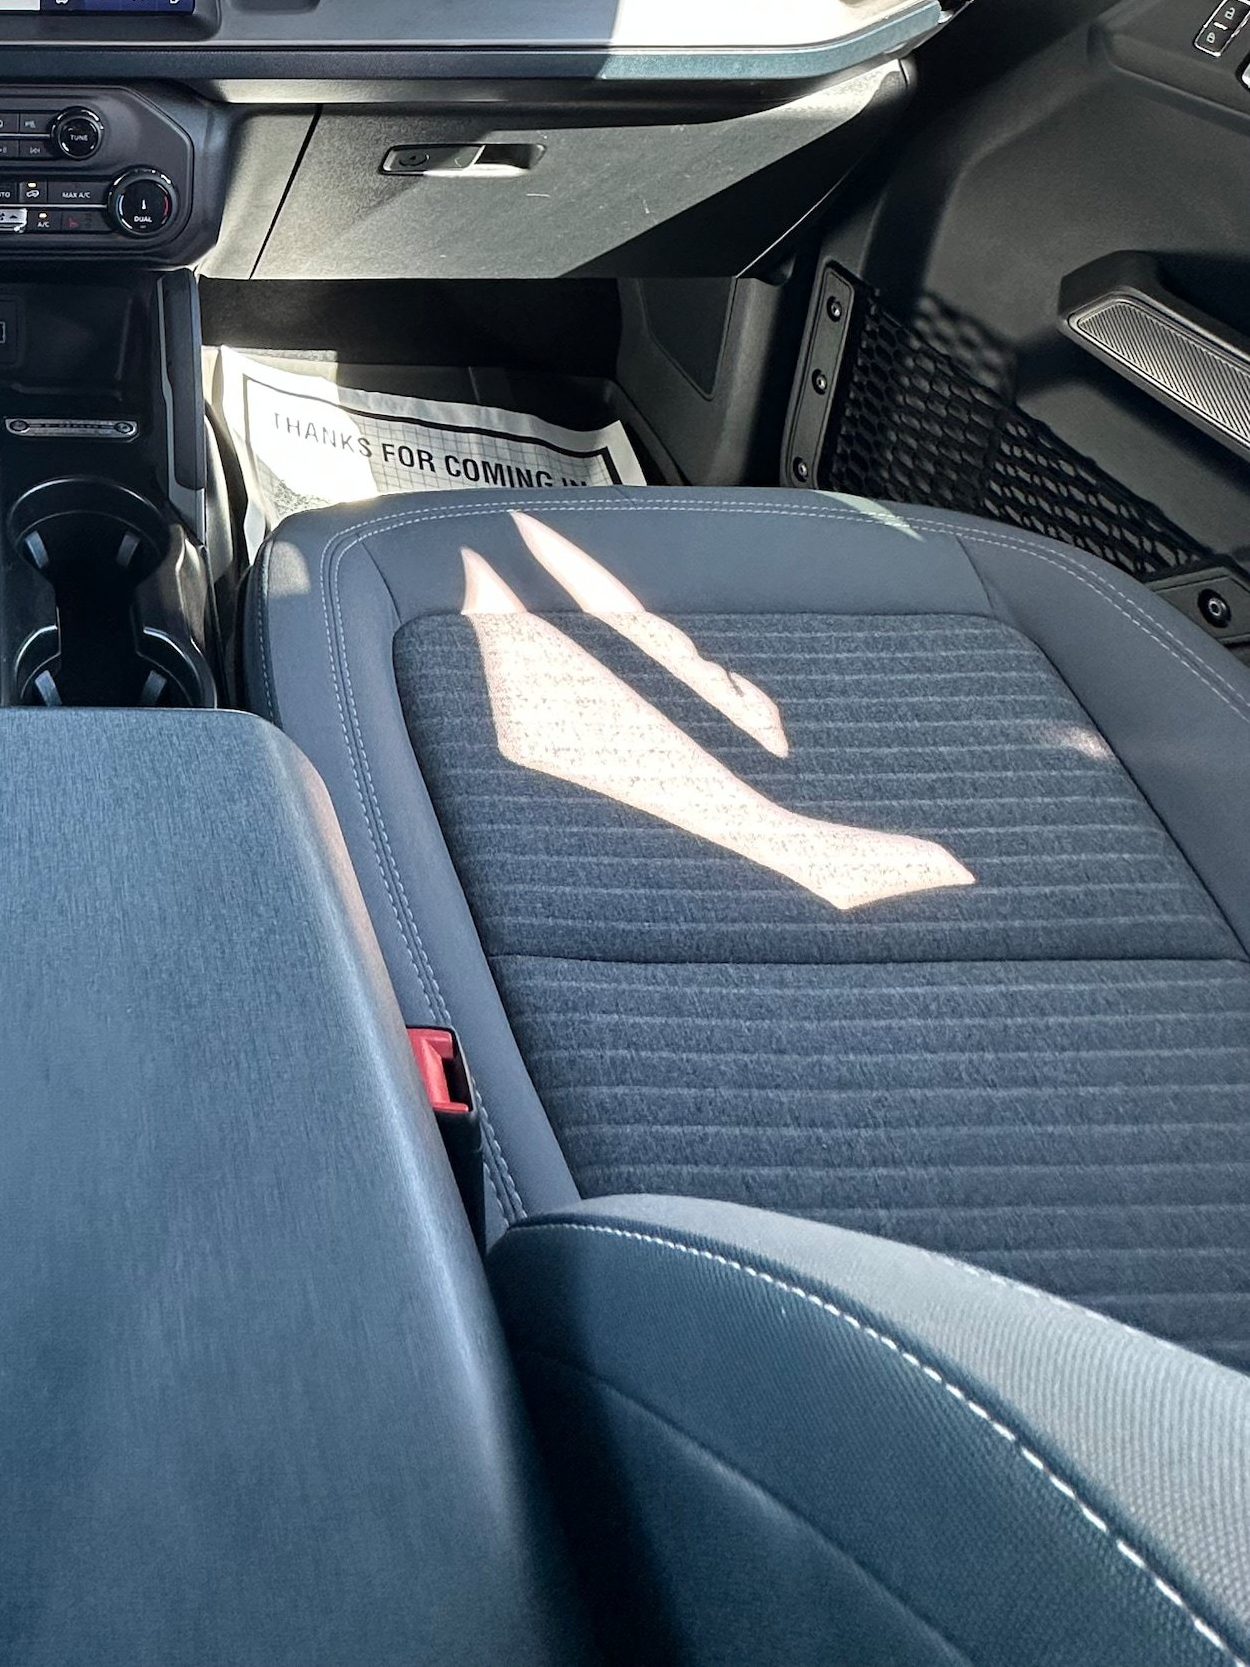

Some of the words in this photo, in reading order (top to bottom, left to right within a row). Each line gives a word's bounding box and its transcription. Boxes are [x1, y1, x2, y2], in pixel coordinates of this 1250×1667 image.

[274, 412, 372, 458] THANKS
[382, 443, 437, 473] FOR
[444, 453, 552, 488] COMING
